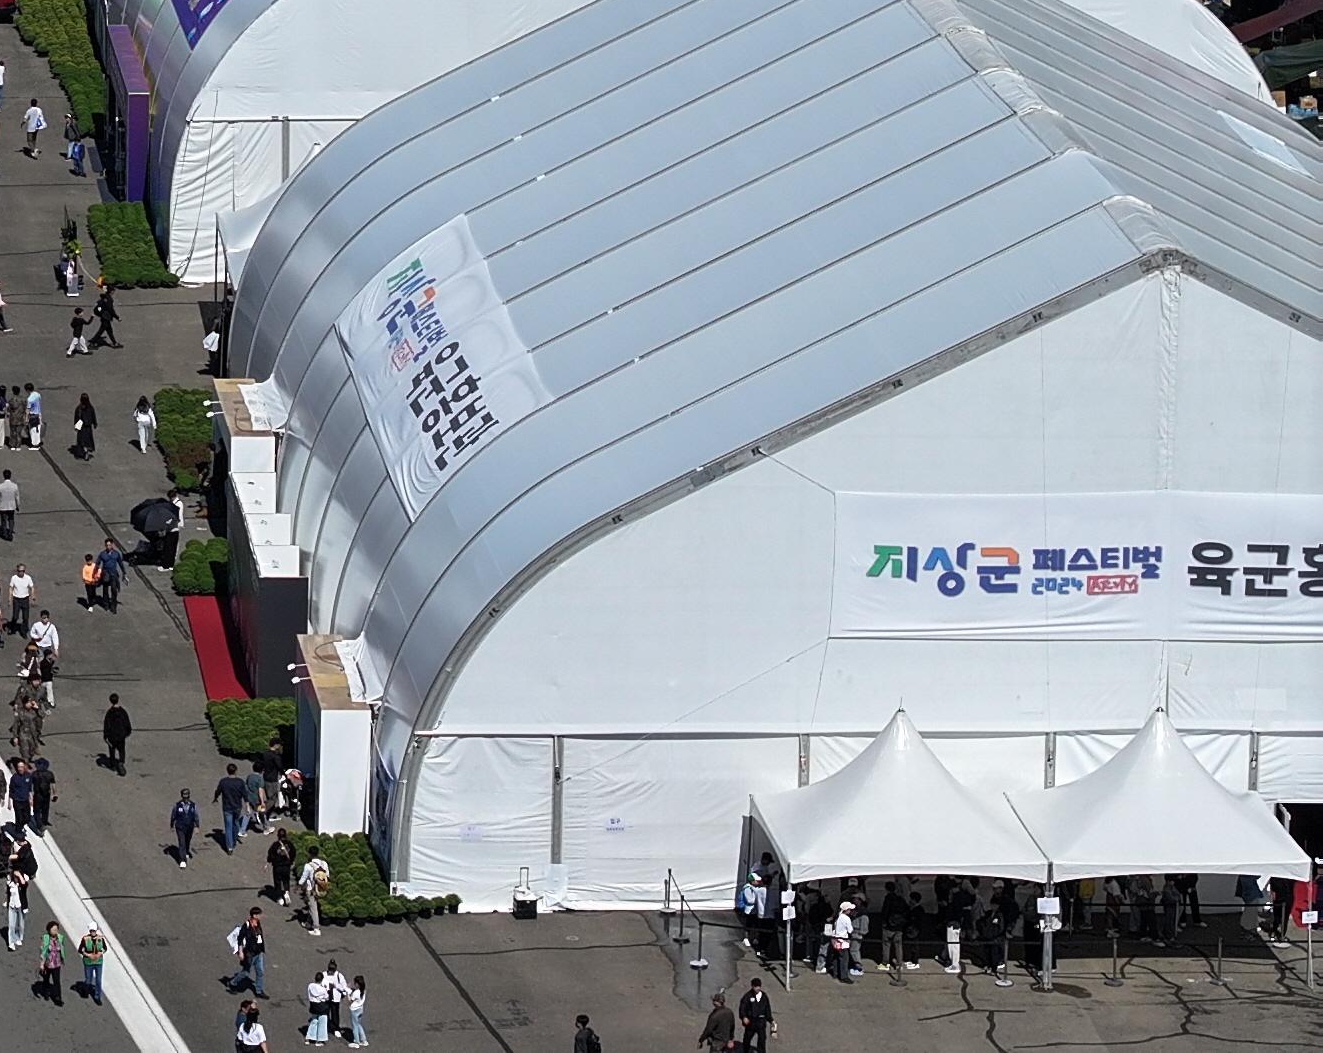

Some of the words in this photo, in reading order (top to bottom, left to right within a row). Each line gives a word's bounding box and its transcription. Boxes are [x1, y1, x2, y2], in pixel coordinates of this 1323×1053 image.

[376, 259, 436, 338] 지상군
[412, 302, 449, 364] 페스티벌
[405, 342, 500, 472] 육군홍보관
[866, 542, 1021, 597] 지상군
[1032, 546, 1163, 579] 페스티벌
[1031, 578, 1084, 596] 2024
